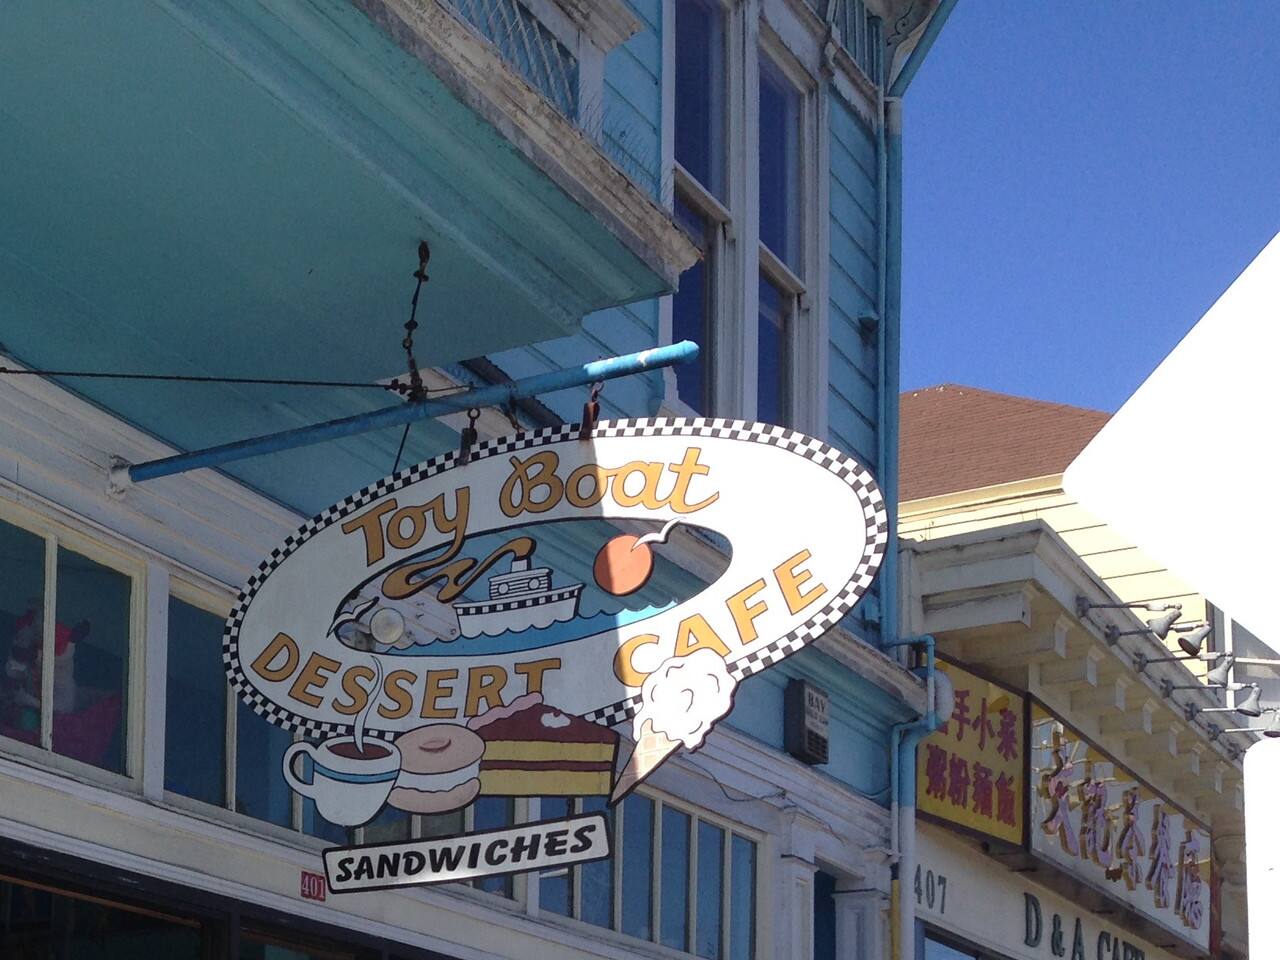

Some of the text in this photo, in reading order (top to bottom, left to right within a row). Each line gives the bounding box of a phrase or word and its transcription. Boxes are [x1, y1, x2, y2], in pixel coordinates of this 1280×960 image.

[342, 446, 720, 567] Toy Boat
[250, 548, 829, 720] DESSERT CAFE
[937, 689, 1019, 762] 手小菜
[335, 823, 598, 882] SANDWICHES
[301, 875, 326, 900] 401
[913, 863, 948, 916] 407
[1023, 891, 1043, 948] D
[1051, 914, 1066, 957] &
